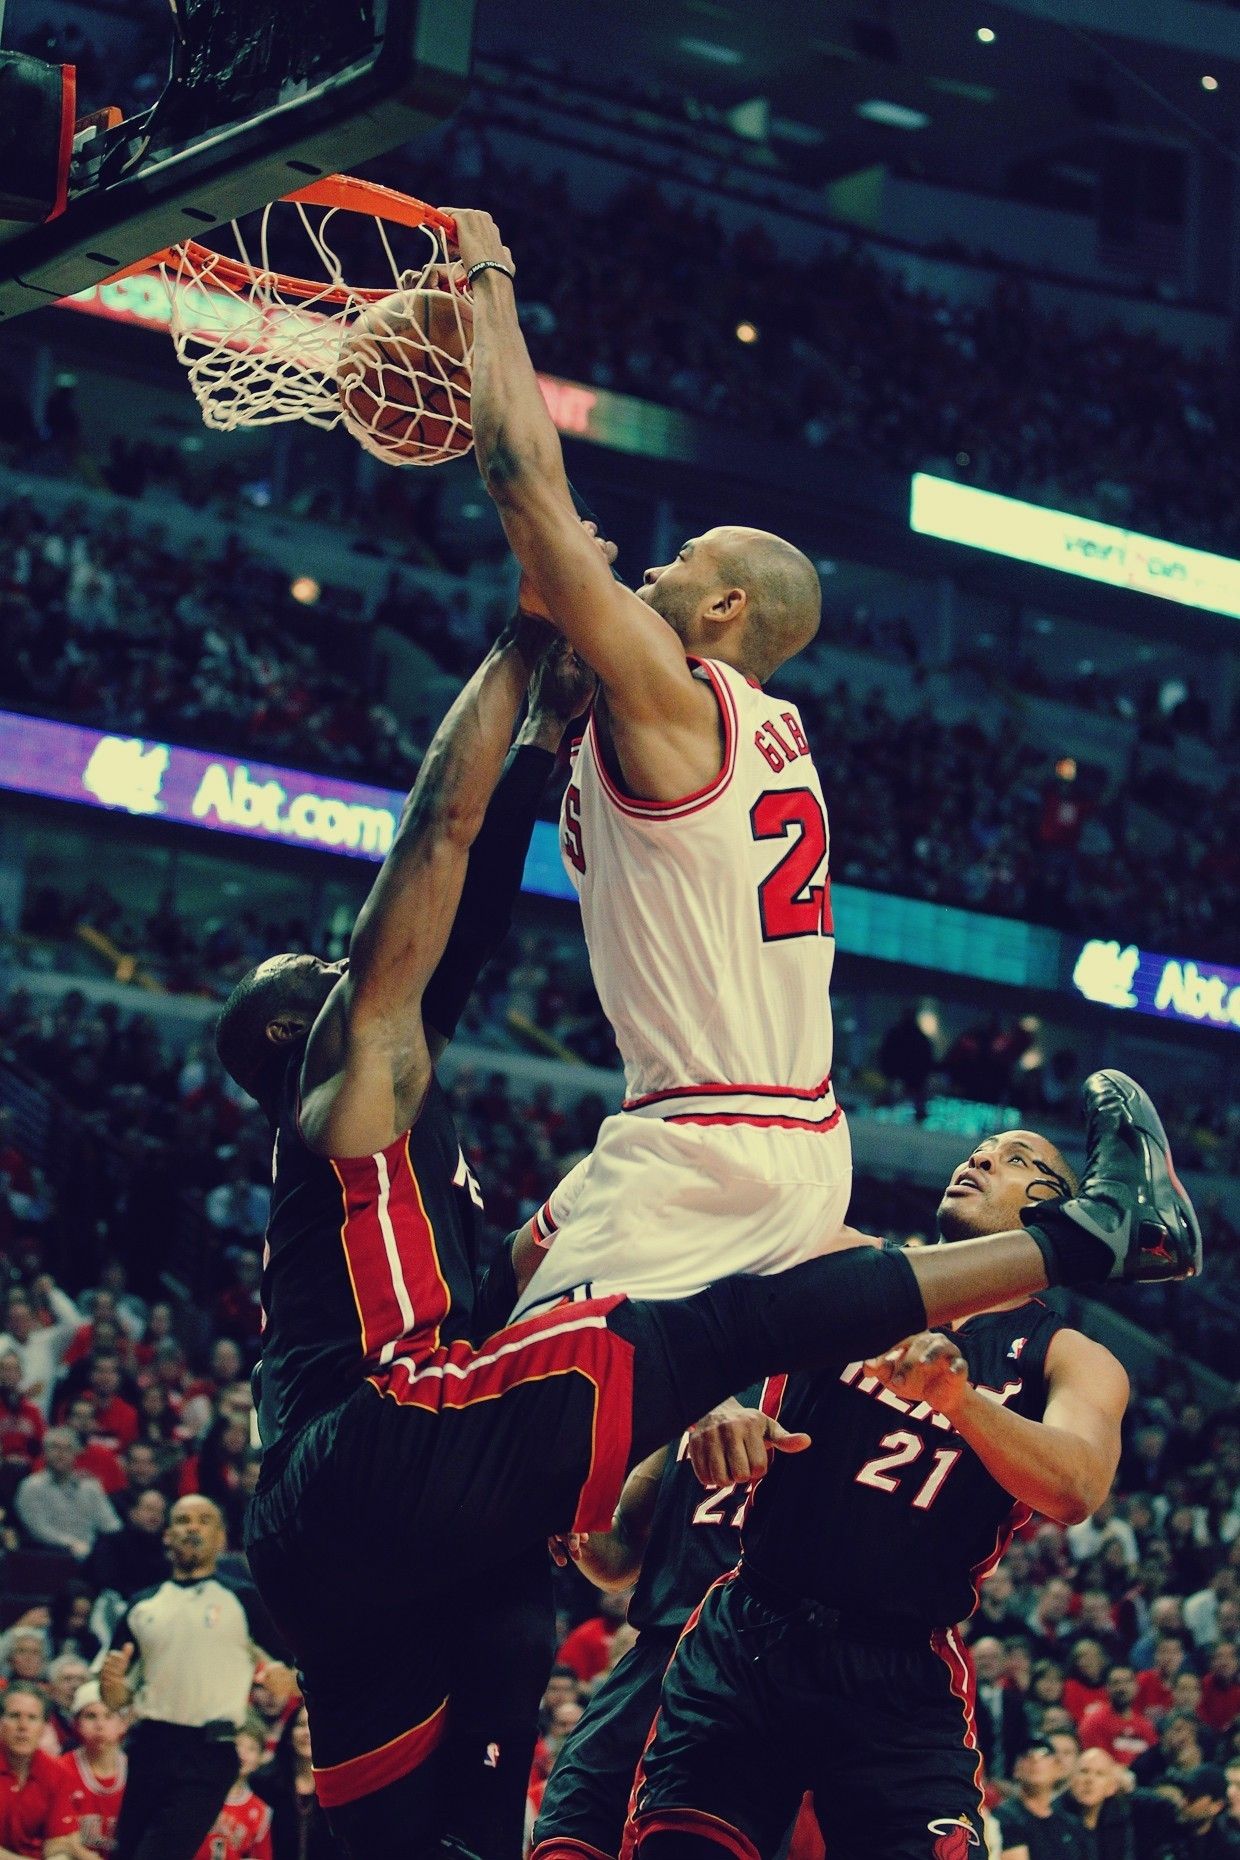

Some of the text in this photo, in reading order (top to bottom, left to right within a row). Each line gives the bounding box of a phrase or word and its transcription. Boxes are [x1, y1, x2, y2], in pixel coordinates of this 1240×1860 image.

[1064, 533, 1188, 582] verion
[192, 763, 396, 853] Abt.com
[749, 786, 834, 943] 2
[855, 1429, 963, 1511] 21
